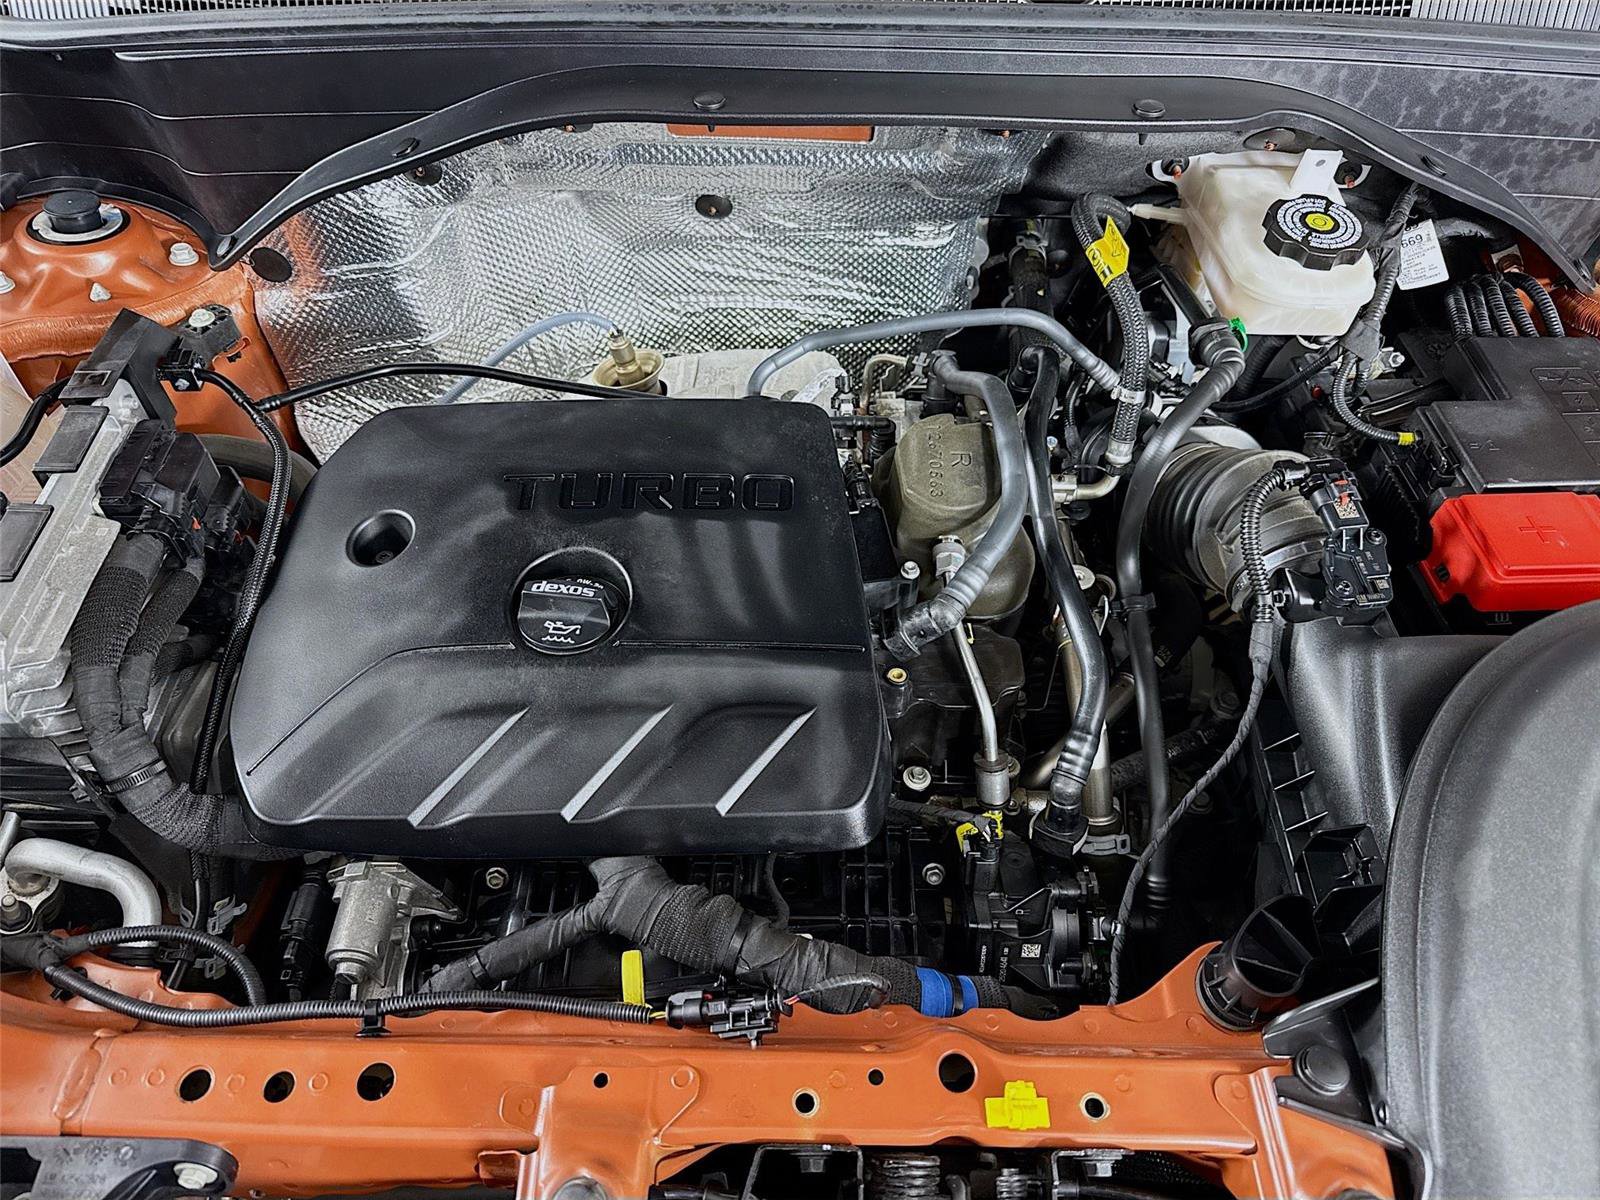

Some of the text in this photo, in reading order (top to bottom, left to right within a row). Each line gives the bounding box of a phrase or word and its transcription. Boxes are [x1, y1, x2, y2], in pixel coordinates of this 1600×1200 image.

[950, 451, 972, 467] R
[503, 473, 795, 510] TURBO
[531, 581, 596, 597] dexos
